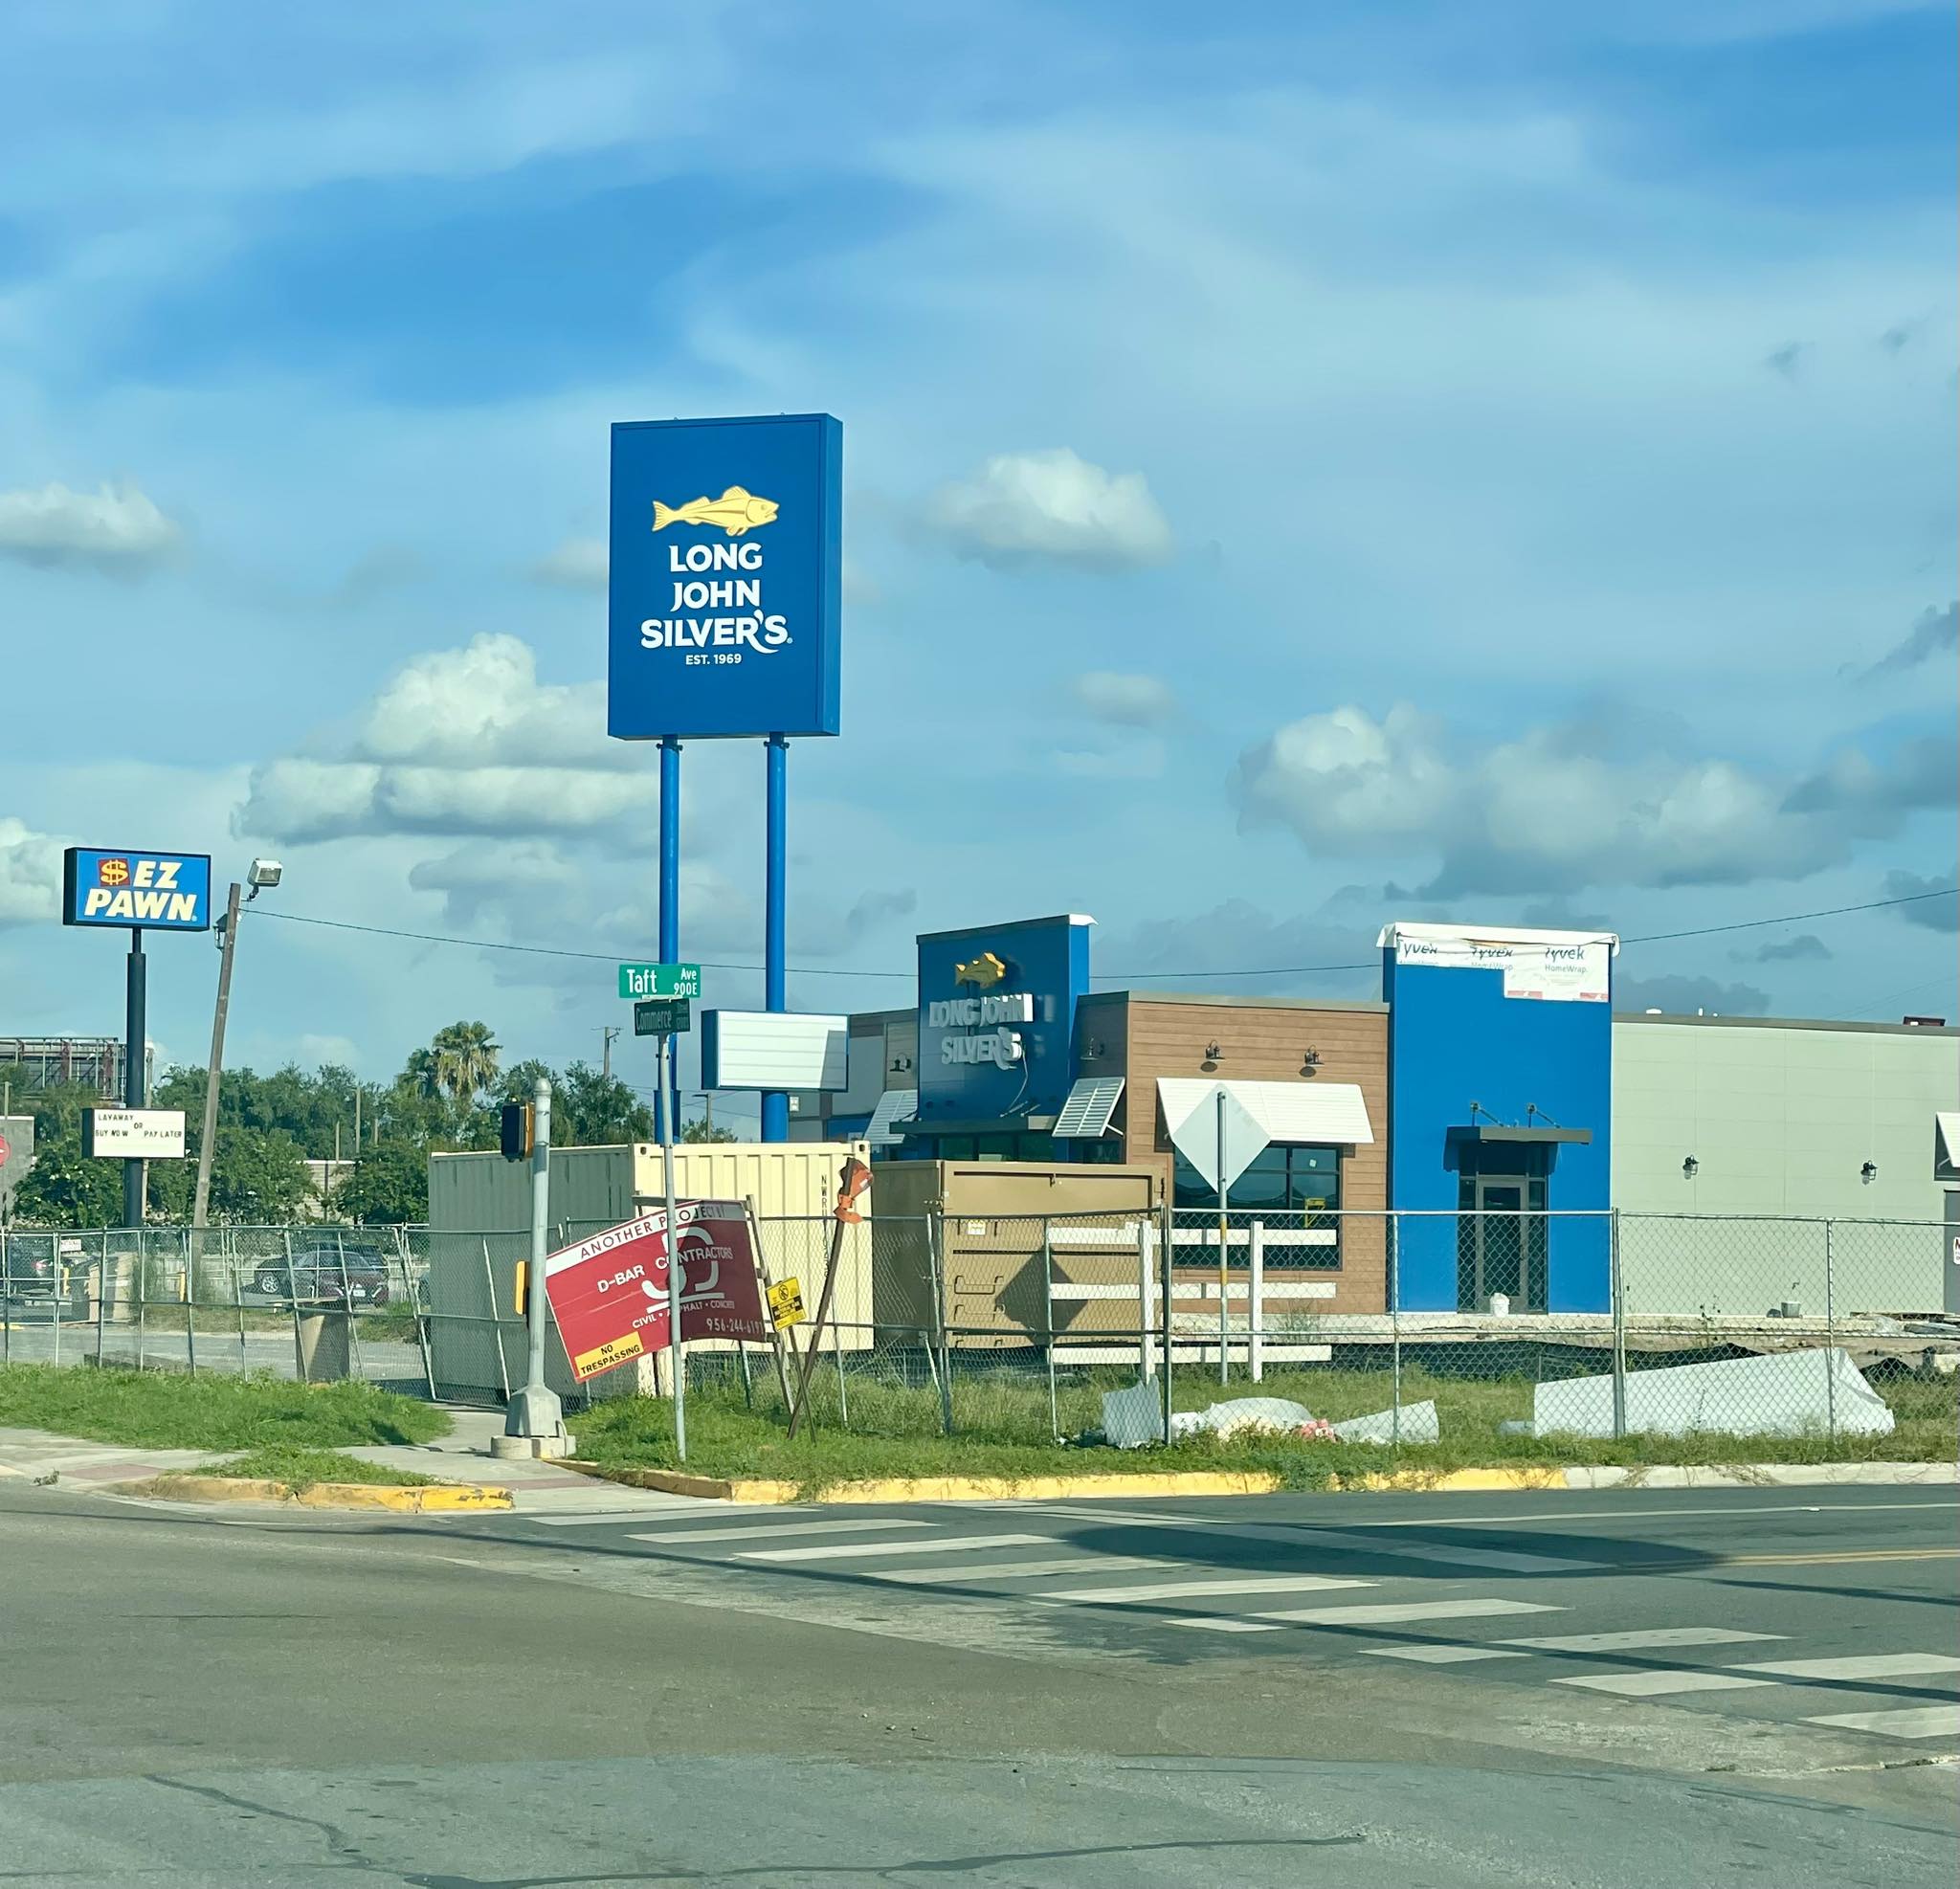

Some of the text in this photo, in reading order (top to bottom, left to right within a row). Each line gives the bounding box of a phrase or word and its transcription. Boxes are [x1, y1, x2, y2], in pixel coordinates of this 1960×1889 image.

[669, 542, 763, 572] LONG
[670, 579, 761, 612] JOHN
[640, 609, 789, 654] SILVER'S
[685, 653, 743, 665] EST. 1969
[132, 860, 183, 889] EZ
[83, 888, 197, 922] PAWN
[627, 967, 697, 993] Taft Ave
[674, 982, 698, 995] 900E
[635, 1007, 672, 1031] Commerce
[929, 993, 1034, 1028] LONG JOHN
[133, 1122, 144, 1130] OR
[144, 1130, 158, 1139] PAY
[160, 1130, 183, 1139] LATER
[581, 1221, 654, 1259] ANOTHER
[658, 1206, 715, 1229] POJECT
[596, 1246, 734, 1293] D-BAR CNTRACTORS
[632, 1313, 657, 1329] CIVIL
[580, 1344, 641, 1375] TRESPASSING
[600, 1344, 613, 1356] NO
